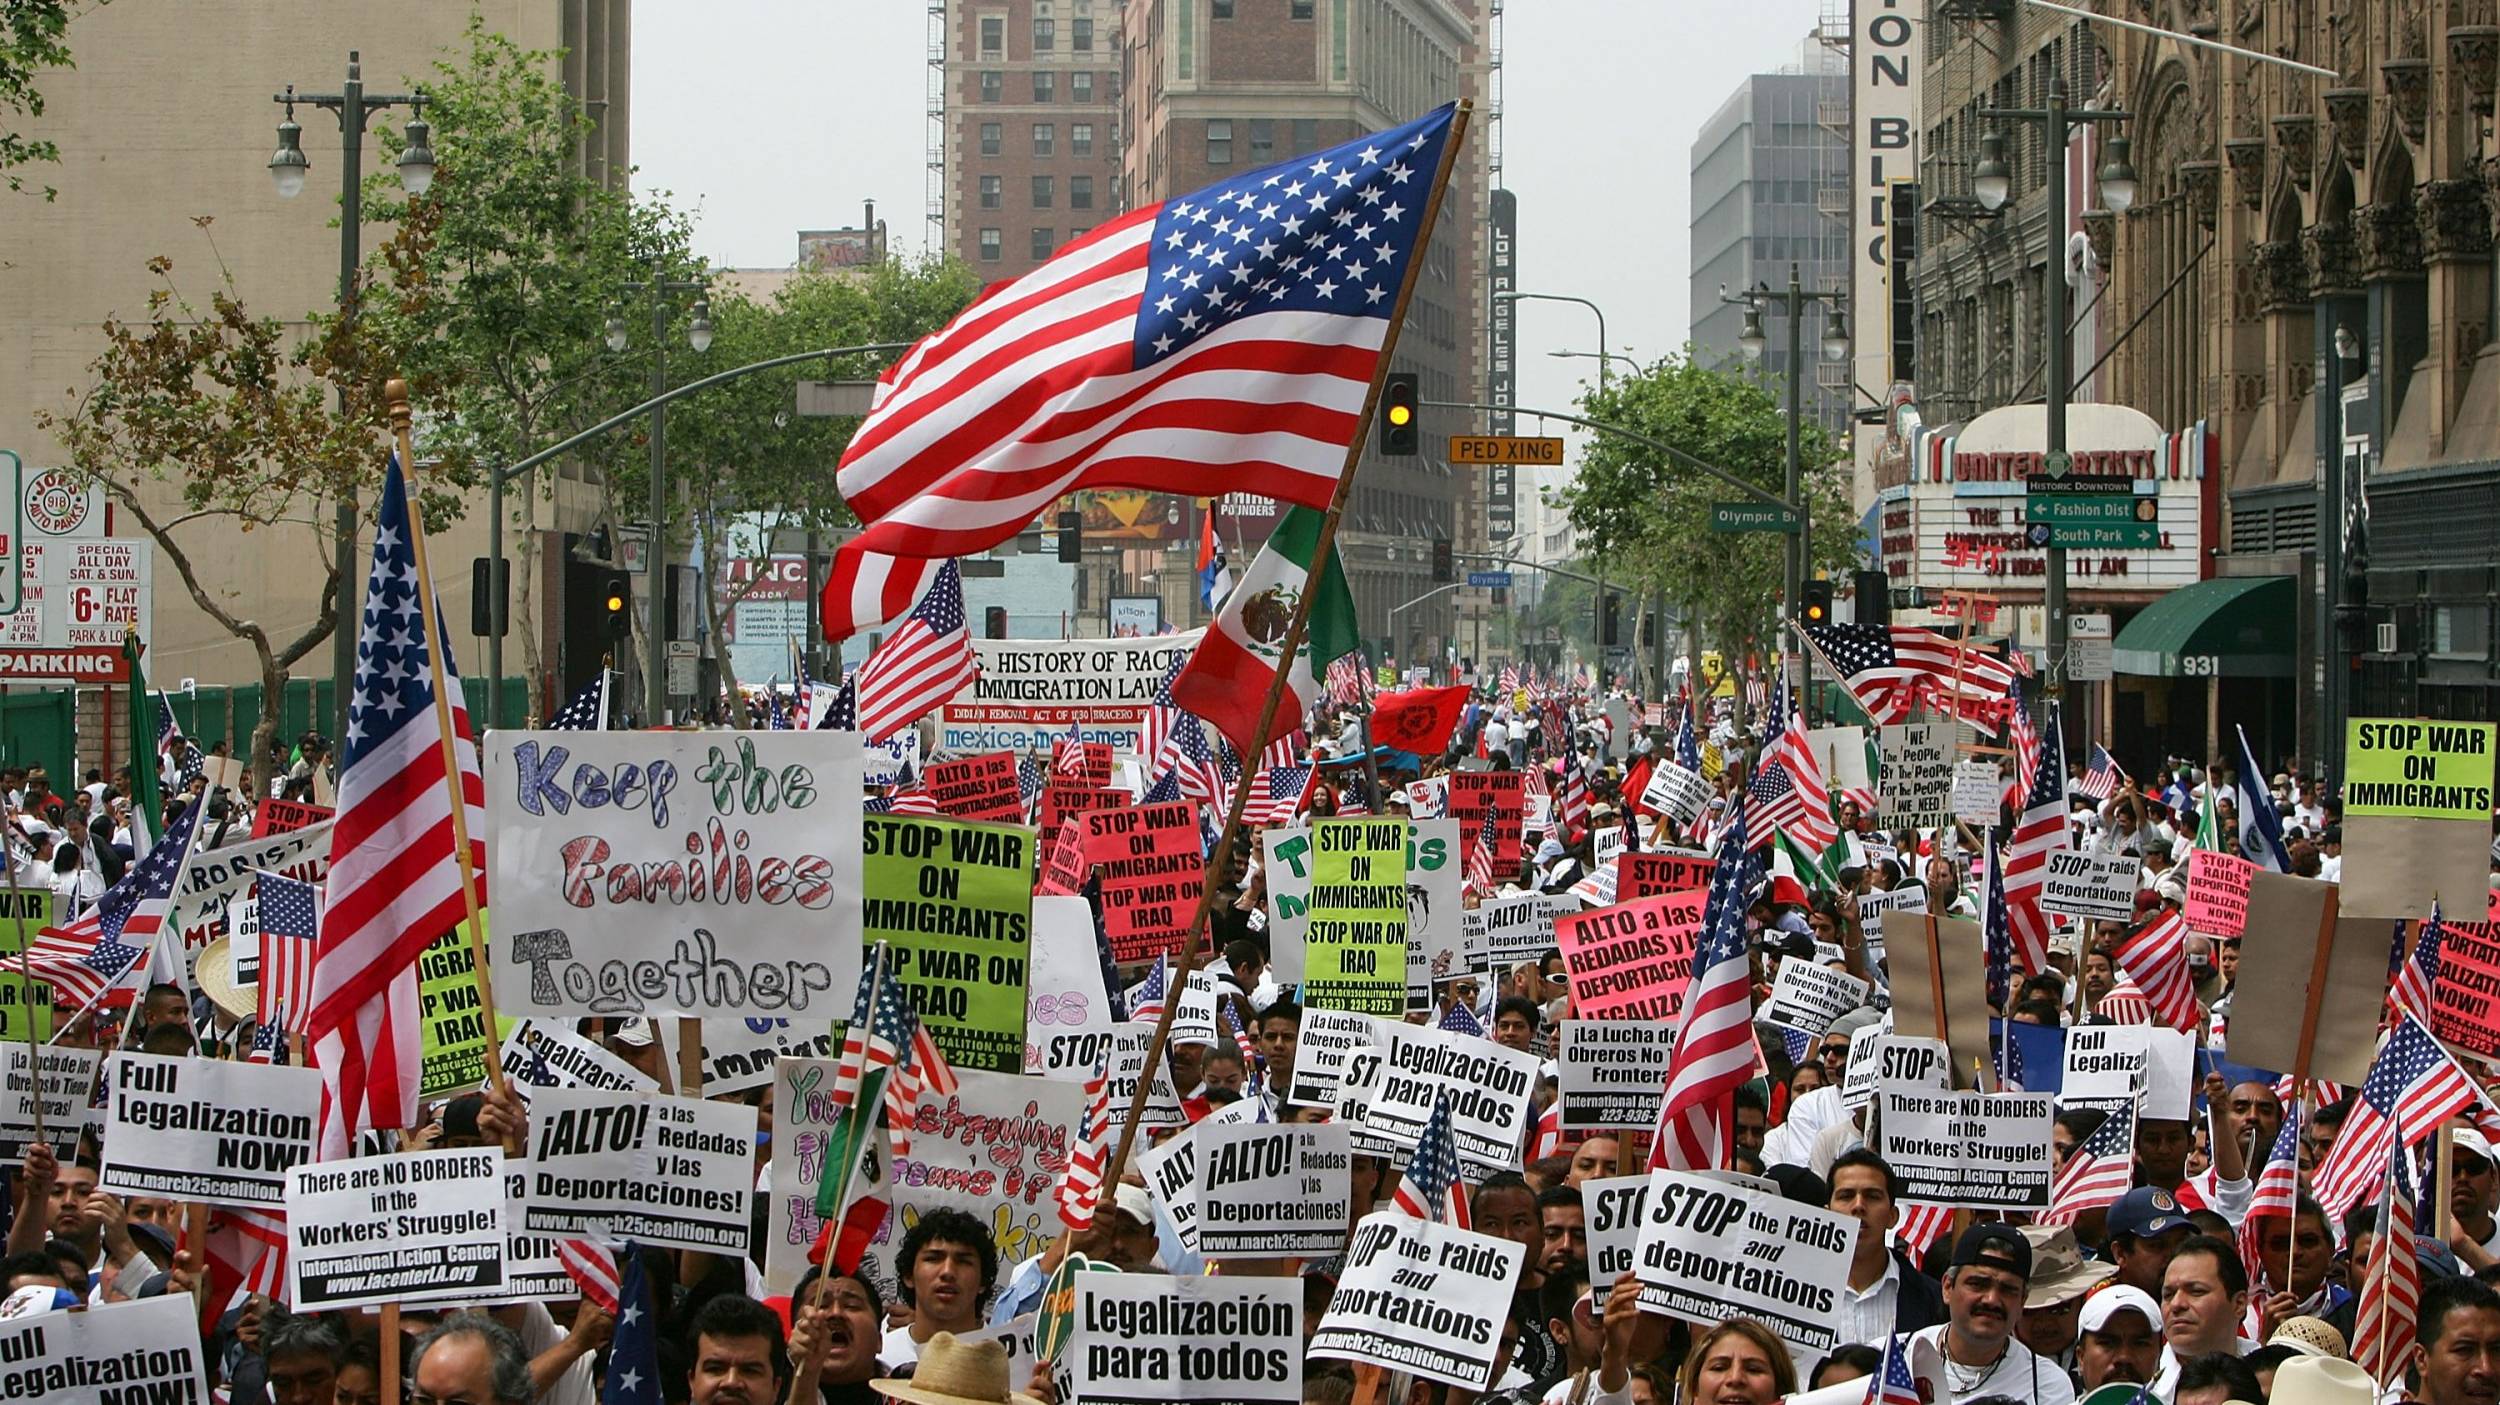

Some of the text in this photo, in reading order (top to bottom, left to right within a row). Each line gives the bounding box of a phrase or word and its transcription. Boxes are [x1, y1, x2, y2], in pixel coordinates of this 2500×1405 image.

[1496, 227, 1509, 372] LOS AGELES
[1461, 441, 1553, 460] PED XING
[47, 496, 66, 508] 918
[2053, 503, 2130, 517] Fashion Dist
[29, 503, 85, 531] AUTO PARKS
[1719, 510, 1775, 526] Olympic
[1967, 507, 2000, 527] THE
[2054, 528, 2123, 542] South Park
[77, 545, 132, 555] SPECIAL
[78, 555, 130, 567] ALL DAY
[70, 568, 138, 580] SAT. & SUN.
[2100, 556, 2129, 576] AM
[106, 587, 138, 604] FLAT
[13, 615, 36, 623] RATE
[105, 606, 138, 623] RATE
[1118, 606, 1146, 618] kitson
[10, 633, 16, 641] 4
[69, 629, 107, 643] PARK &
[2069, 640, 2083, 649] 30
[0, 654, 114, 673] PARKING
[998, 652, 1090, 673] HISTORY
[1092, 652, 1118, 672] OF
[2069, 649, 2081, 658] 31
[2070, 659, 2084, 668] 40
[2183, 655, 2219, 676] 931
[2071, 669, 2083, 678] 42
[974, 678, 1113, 700] IMMIGRATION
[954, 708, 1133, 721] INDIAN REMOVAL ACT OF BRACERO
[2359, 723, 2486, 755] STOP WAR
[936, 764, 971, 786] ALTO
[2403, 755, 2436, 781] ON
[513, 739, 678, 829] Keep
[694, 735, 818, 816] the
[1454, 775, 1520, 790] STOP WAR
[1052, 791, 1122, 808] STOP THE
[2348, 783, 2490, 811] IMMIGRANTS
[267, 803, 305, 825] STOP
[1089, 805, 1191, 836] STOP WAR
[863, 820, 943, 860] STOP
[950, 827, 1023, 870] WAR
[1129, 833, 1155, 856] ON
[1320, 824, 1402, 852] STOP WAR
[559, 815, 834, 910] Families
[1350, 855, 1371, 882] ON
[1633, 859, 1688, 883] STOP
[2049, 853, 2136, 878] STOP raids
[2200, 853, 2233, 871] STOP
[918, 864, 960, 901] ON
[2203, 866, 2242, 885] RAIDS
[1138, 883, 1177, 905] WAR
[1312, 884, 1404, 910] IMMIGRANTS
[2047, 880, 2132, 903] deportations
[1130, 905, 1174, 930] IRAQ
[1487, 901, 1533, 932] ¡ALTO!
[1574, 905, 1701, 946] ALTO a las
[1309, 920, 1406, 945] STOP WAR ON
[1340, 949, 1377, 977] IRAQ
[1568, 933, 1669, 975] REDADAS
[512, 928, 833, 1015] Together
[917, 948, 1024, 987] WAR ON
[1784, 973, 1826, 995] Obreros
[1316, 999, 1393, 1012] (323) 228-2753
[1117, 1036, 1136, 1052] the
[1302, 1031, 1351, 1049] Obreros
[1573, 1026, 1654, 1045] ¡La Lucha
[2071, 1031, 2106, 1051] Full
[1389, 1035, 1528, 1098] Legalización
[1567, 1046, 1638, 1064] Obreros
[1882, 1046, 1935, 1081] STOP
[119, 1059, 178, 1094] Full
[1381, 1075, 1435, 1109] para
[1565, 1095, 1637, 1109] International
[117, 1093, 312, 1140] Legalization
[1889, 1093, 1932, 1114] There
[1934, 1099, 1958, 1116] are
[1960, 1098, 1980, 1117] NO
[1983, 1099, 2048, 1119] BORDERS
[536, 1102, 696, 1162] ¡ALTO! las
[1948, 1118, 1987, 1138] in the
[657, 1126, 748, 1157] Redadas
[1888, 1135, 2048, 1163] Workers' Struggle!
[671, 1154, 702, 1178] las
[1205, 1132, 1294, 1192] ¡ALTO!
[1300, 1151, 1347, 1170] Redadas
[298, 1155, 494, 1195] There are NO BORDERS
[1963, 1168, 2048, 1186] Action Center
[370, 1189, 418, 1213] in the
[535, 1172, 744, 1214] Deportaciones!
[1206, 1199, 1347, 1223] Deportaciones!
[1652, 1182, 1749, 1238] STOP
[1748, 1211, 1779, 1235] the
[1785, 1214, 1848, 1254] raids
[298, 1208, 497, 1247] Workers' Struggle!
[397, 1243, 500, 1269] Action Center
[1398, 1236, 1510, 1281] the raids
[1742, 1240, 1786, 1263] and
[300, 1253, 395, 1278] International
[1643, 1239, 1835, 1313] deportations
[1391, 1267, 1439, 1292] and
[1085, 1290, 1294, 1340] Legalización
[1087, 1340, 1289, 1381] para todos
